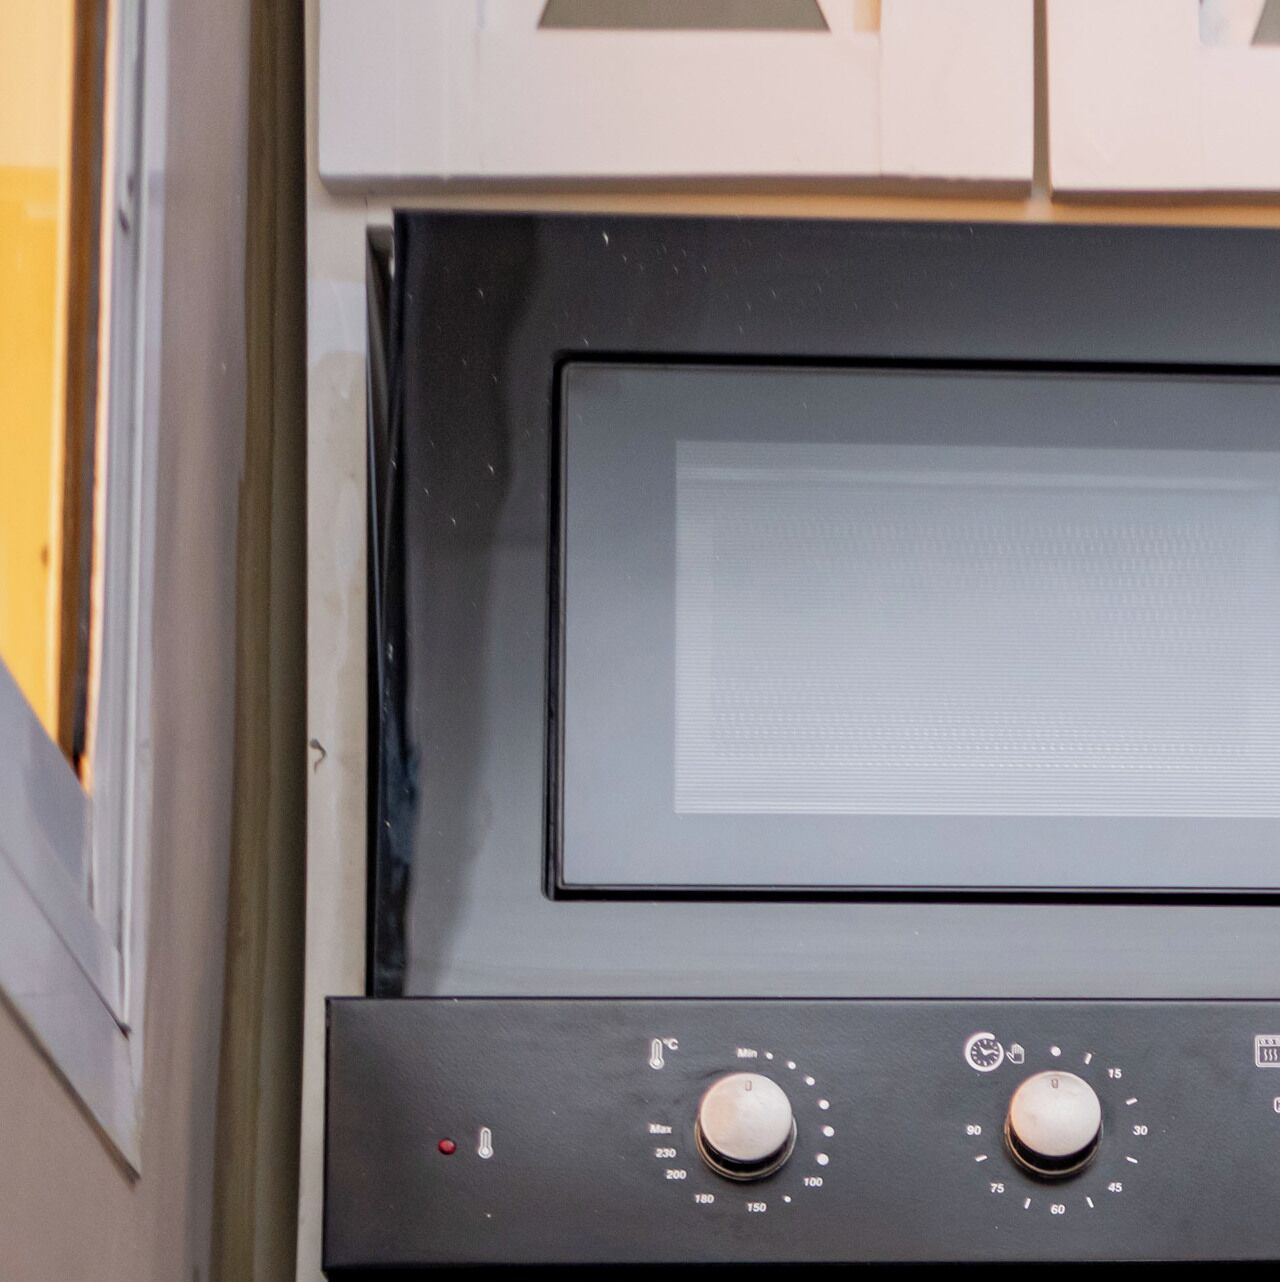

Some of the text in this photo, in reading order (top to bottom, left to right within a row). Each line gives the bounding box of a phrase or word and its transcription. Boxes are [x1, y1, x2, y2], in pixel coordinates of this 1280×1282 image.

[736, 1048, 758, 1059] Min
[1107, 1068, 1122, 1079] 15
[649, 1124, 672, 1134] Max
[966, 1125, 981, 1136] 90
[1133, 1125, 1148, 1136] 30
[655, 1148, 677, 1158] 230
[666, 1169, 687, 1180] 200
[803, 1177, 823, 1187] 100
[990, 1182, 1005, 1193] 75
[1107, 1182, 1123, 1193] 45
[695, 1194, 714, 1204] 180
[747, 1203, 767, 1213] 150
[1050, 1204, 1066, 1215] 60
